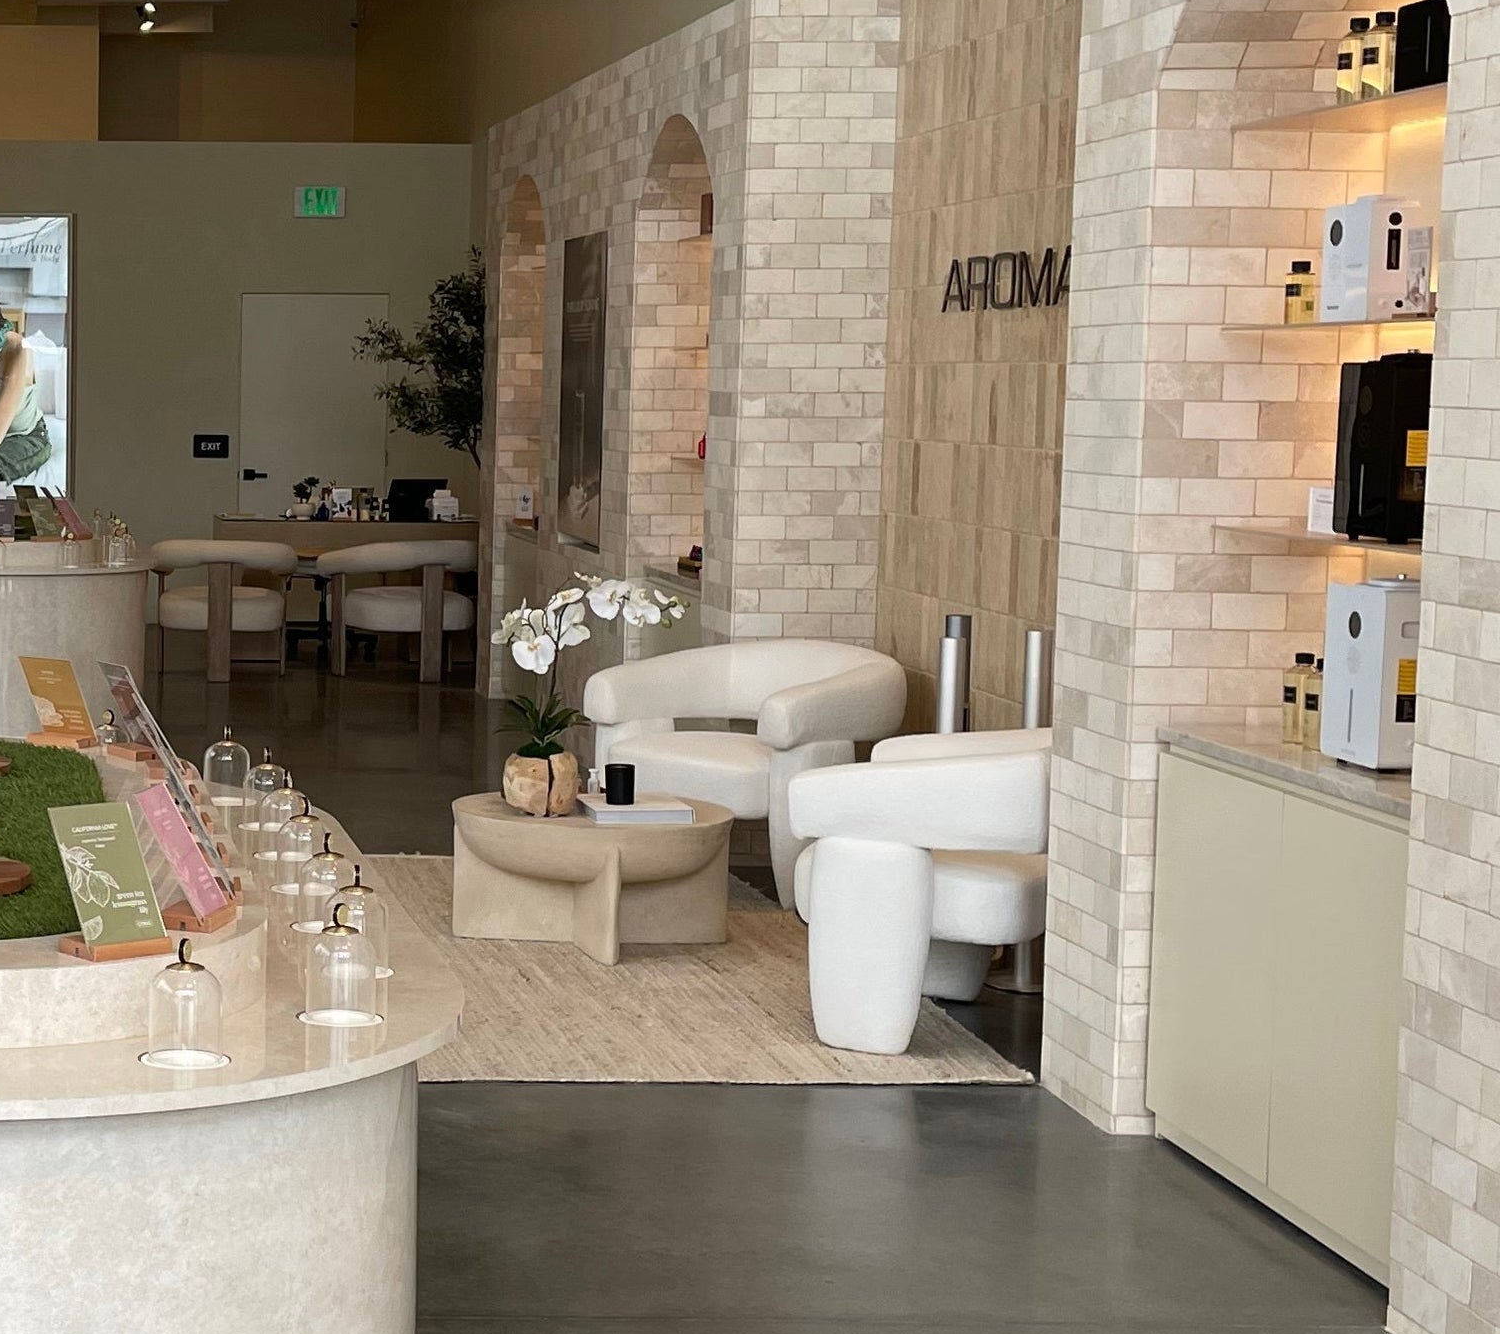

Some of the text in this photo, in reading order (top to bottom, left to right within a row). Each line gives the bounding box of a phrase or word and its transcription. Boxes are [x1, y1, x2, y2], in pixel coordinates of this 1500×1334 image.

[303, 187, 338, 216] EXIT
[1, 239, 62, 257] Perfume
[201, 442, 221, 451] EXIT
